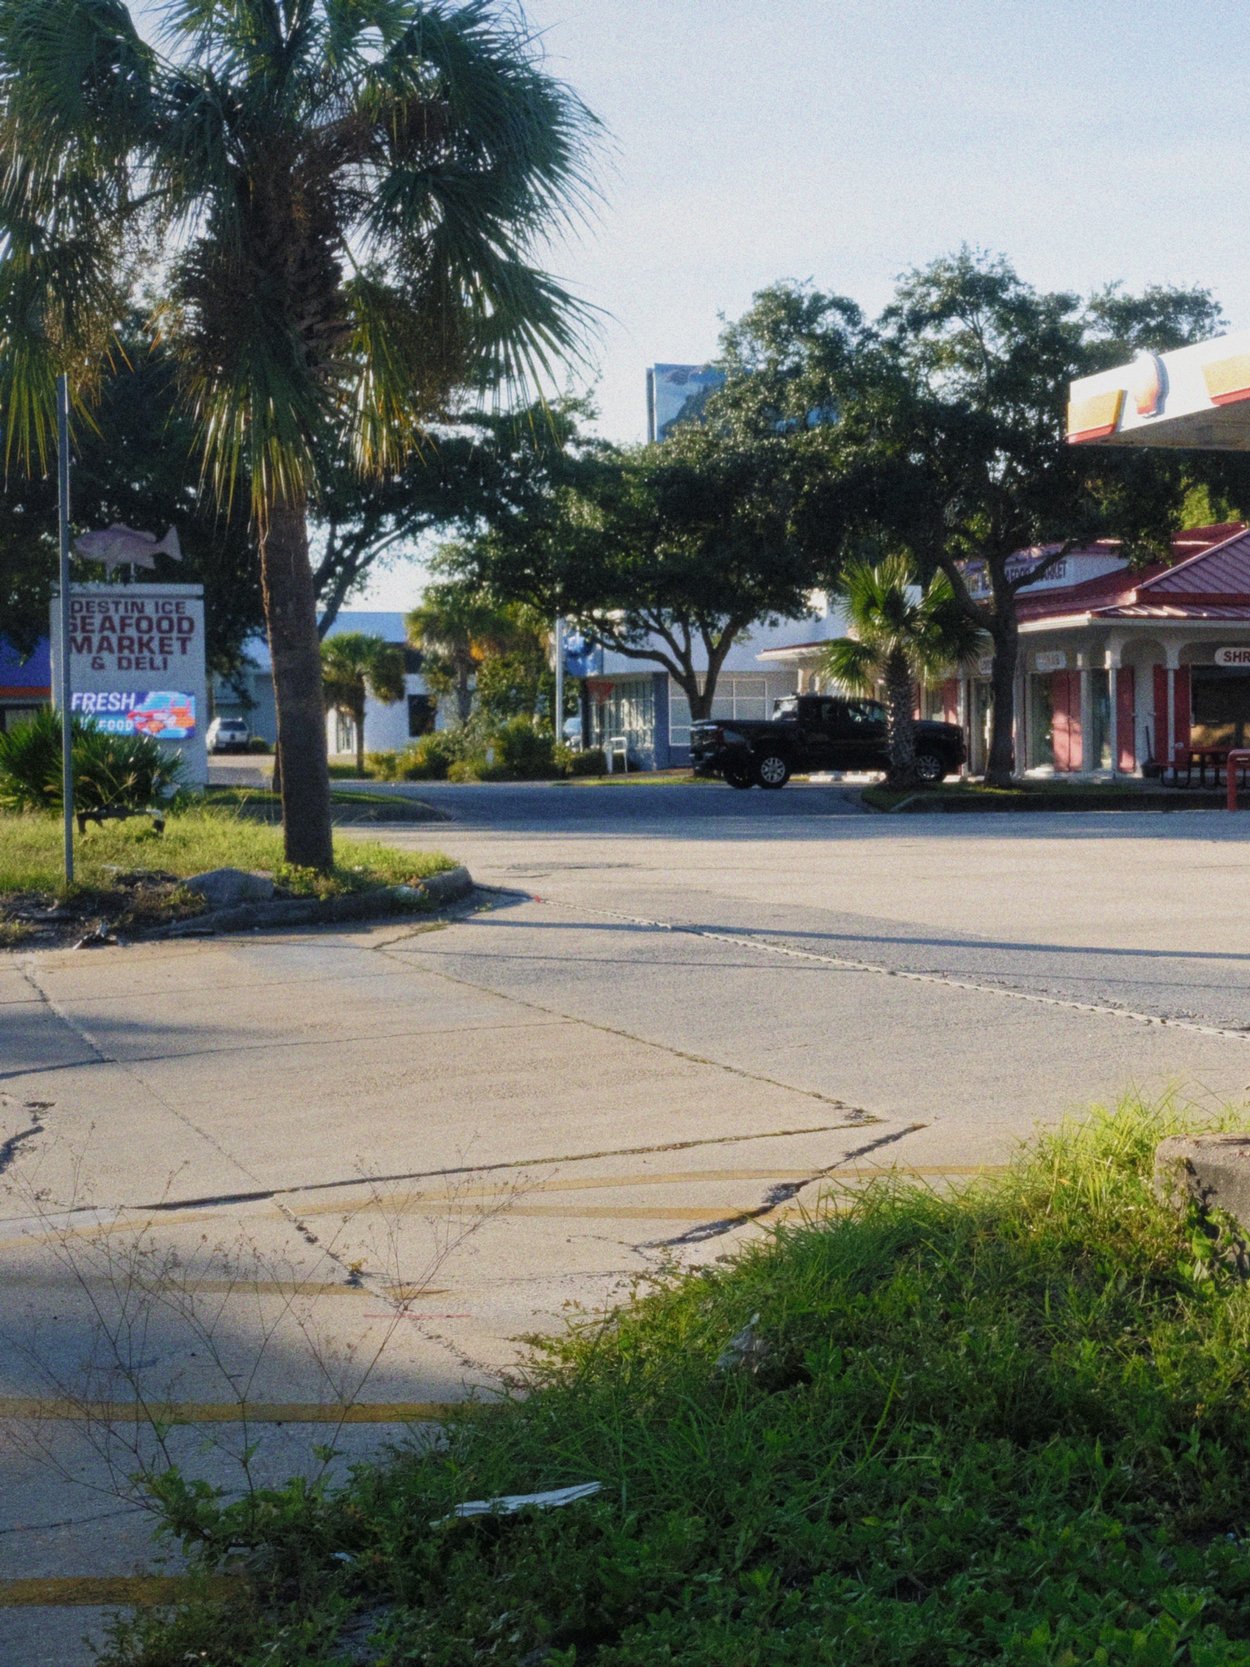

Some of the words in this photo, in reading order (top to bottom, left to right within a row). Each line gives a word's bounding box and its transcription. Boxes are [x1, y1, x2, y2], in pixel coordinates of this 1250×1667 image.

[70, 600, 145, 615] DESTIN
[155, 601, 186, 614] ICE
[69, 635, 192, 655] MARKET
[91, 656, 105, 671] &
[117, 656, 168, 671] DELI
[71, 692, 136, 711] FRESH
